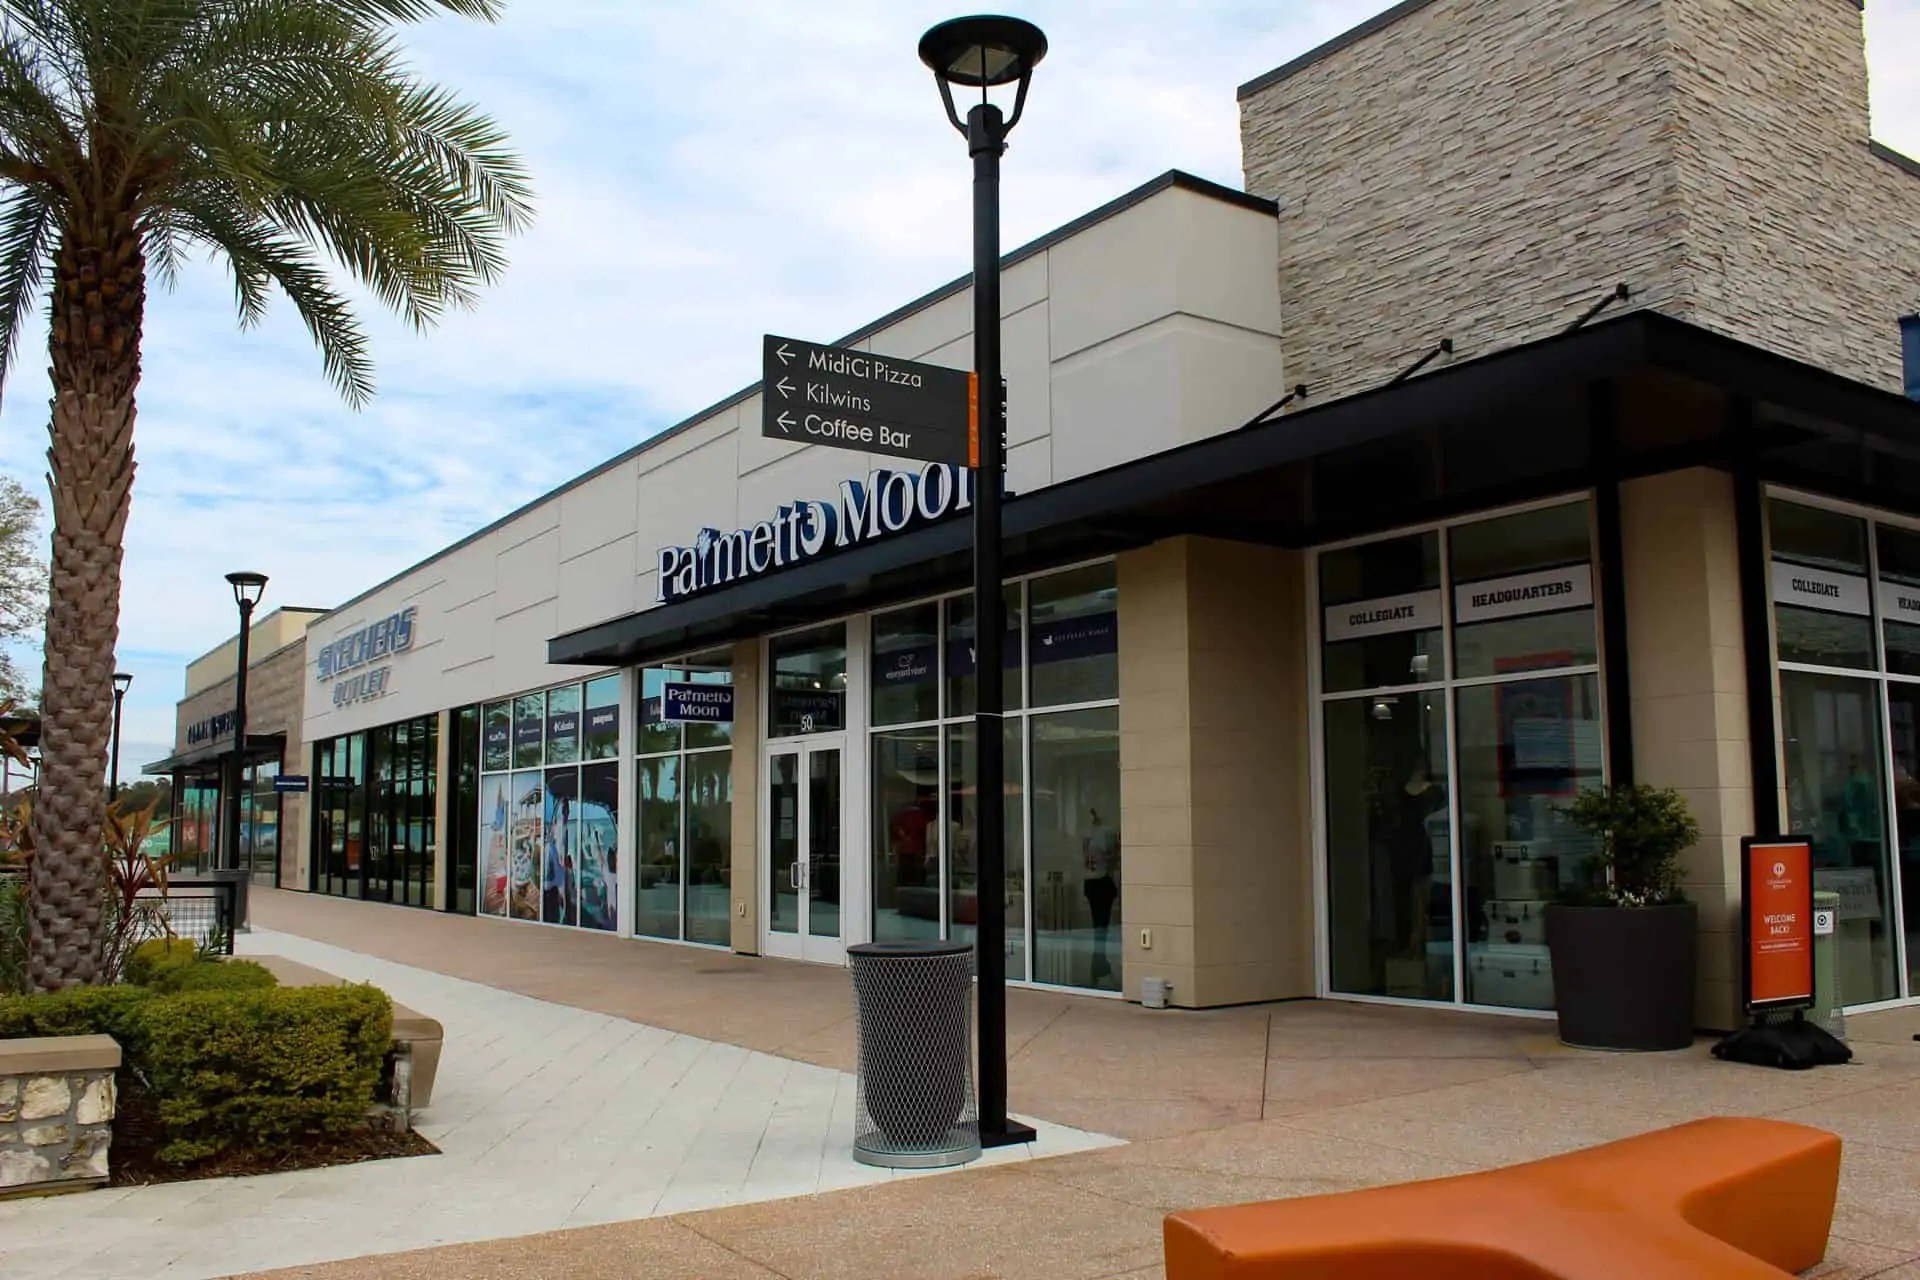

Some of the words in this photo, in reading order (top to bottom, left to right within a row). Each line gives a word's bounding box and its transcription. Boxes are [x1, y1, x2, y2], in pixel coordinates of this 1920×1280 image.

[807, 351, 870, 379] MidiCi
[874, 361, 922, 388] Pizza
[806, 382, 871, 412] Kilwins
[804, 414, 873, 442] Coffee
[879, 426, 911, 449] Bar
[655, 498, 836, 602] Palmetto
[1792, 578, 1840, 598] COLLEGIATE
[1349, 605, 1414, 626] COLLEGIATE
[1471, 581, 1573, 608] HEADQUARTERS
[317, 606, 416, 682] SKECHERS
[668, 688, 732, 703] Palmetto
[679, 703, 720, 718] Moon
[800, 714, 813, 731] 50
[1763, 913, 1796, 924] WELCOME
